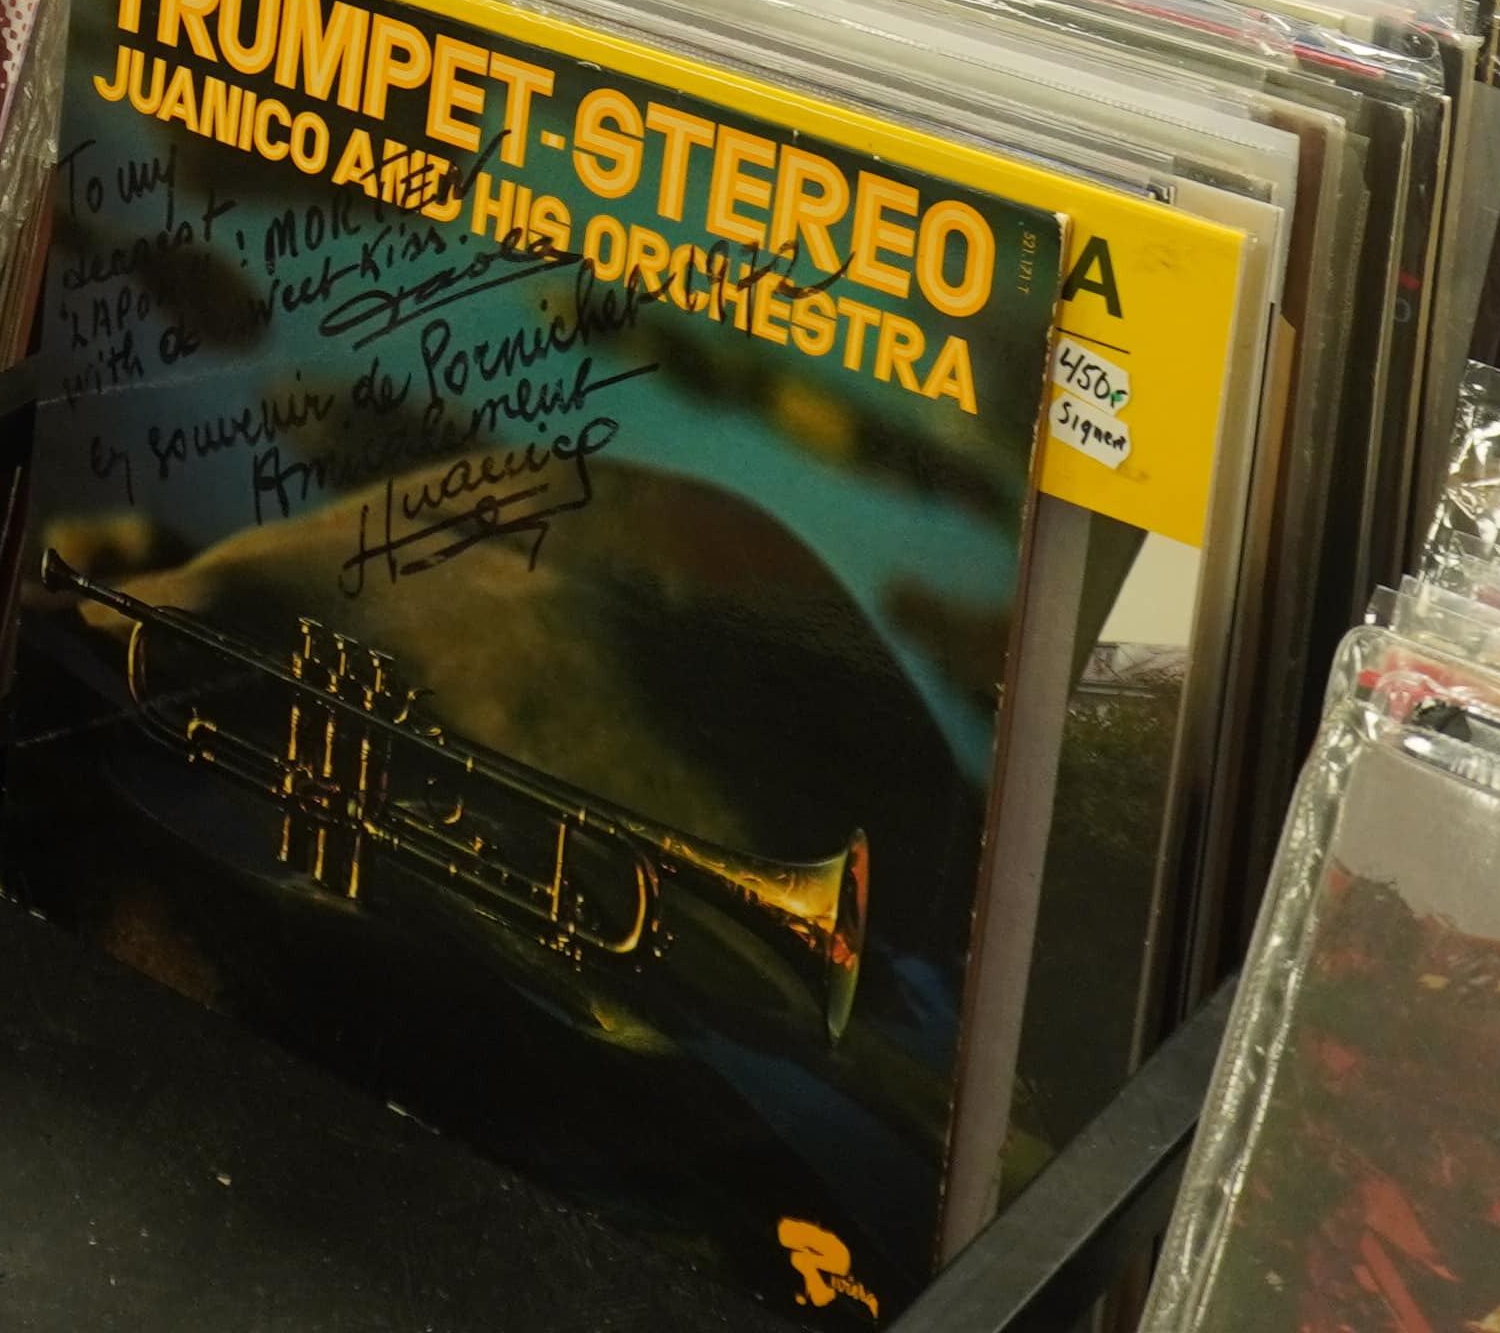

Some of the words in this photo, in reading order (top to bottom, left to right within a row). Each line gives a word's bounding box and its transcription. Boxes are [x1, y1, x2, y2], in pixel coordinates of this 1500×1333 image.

[92, 44, 331, 175] JUANICO
[331, 127, 463, 222] AND
[470, 171, 572, 262] HIS
[582, 213, 979, 416] ORCHESTRA
